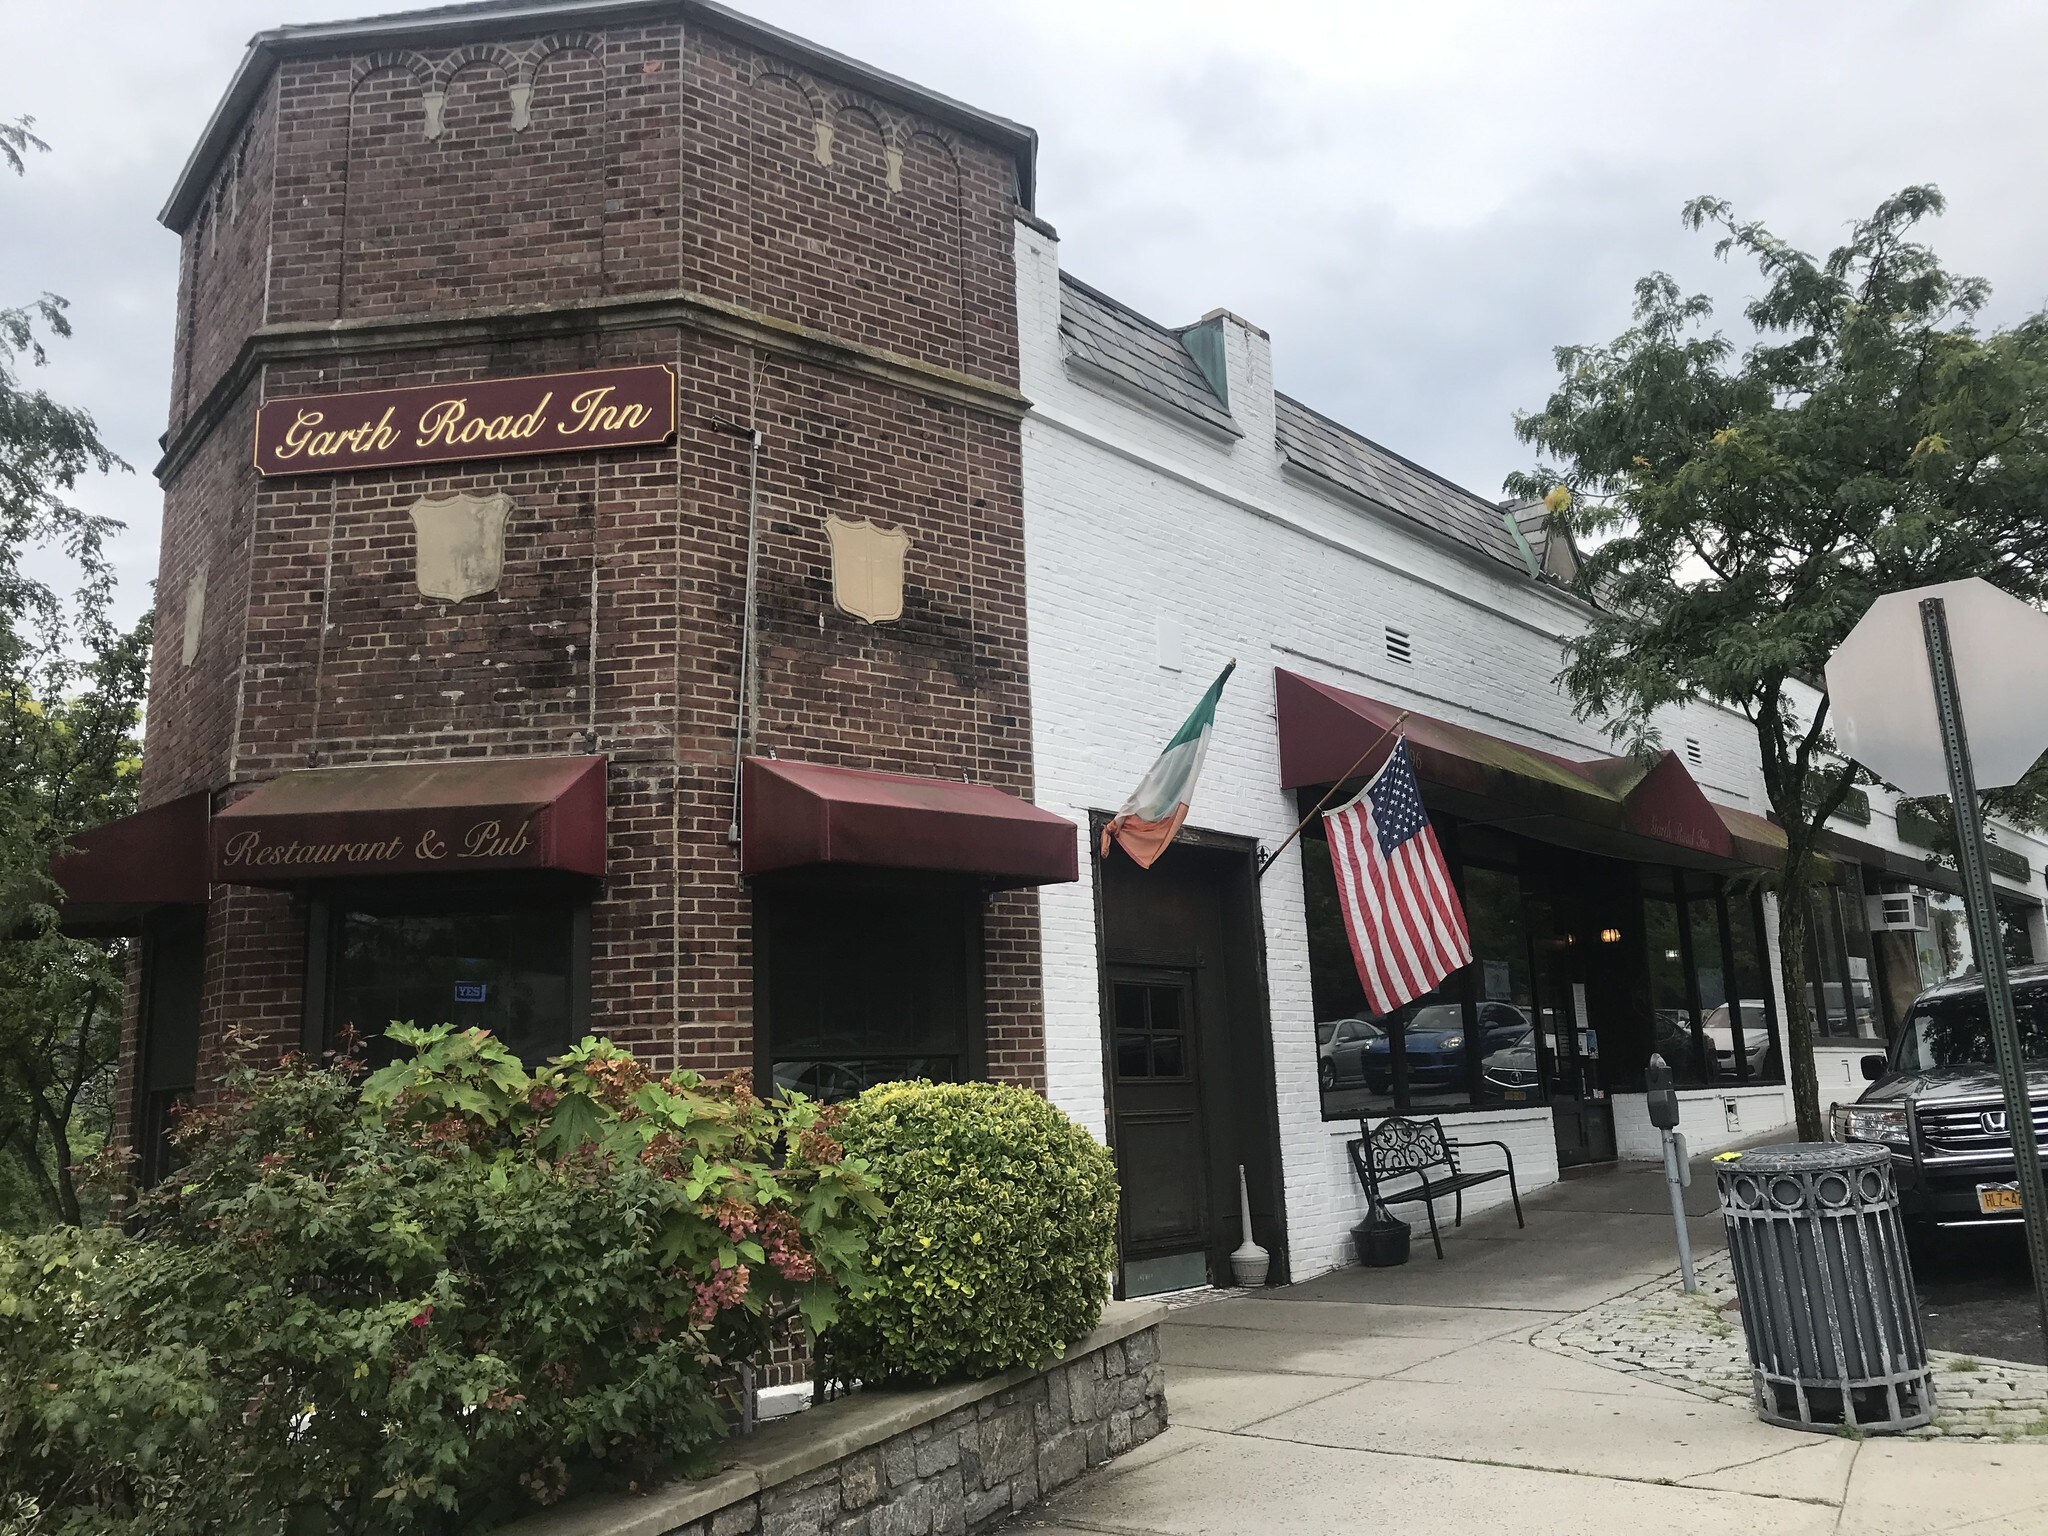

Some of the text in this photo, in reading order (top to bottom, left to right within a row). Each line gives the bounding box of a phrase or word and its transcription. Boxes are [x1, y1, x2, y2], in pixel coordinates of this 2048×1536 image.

[275, 386, 653, 460] Garth Road Inn
[1409, 749, 1422, 769] 96
[223, 819, 534, 868] Restaurant & Pub
